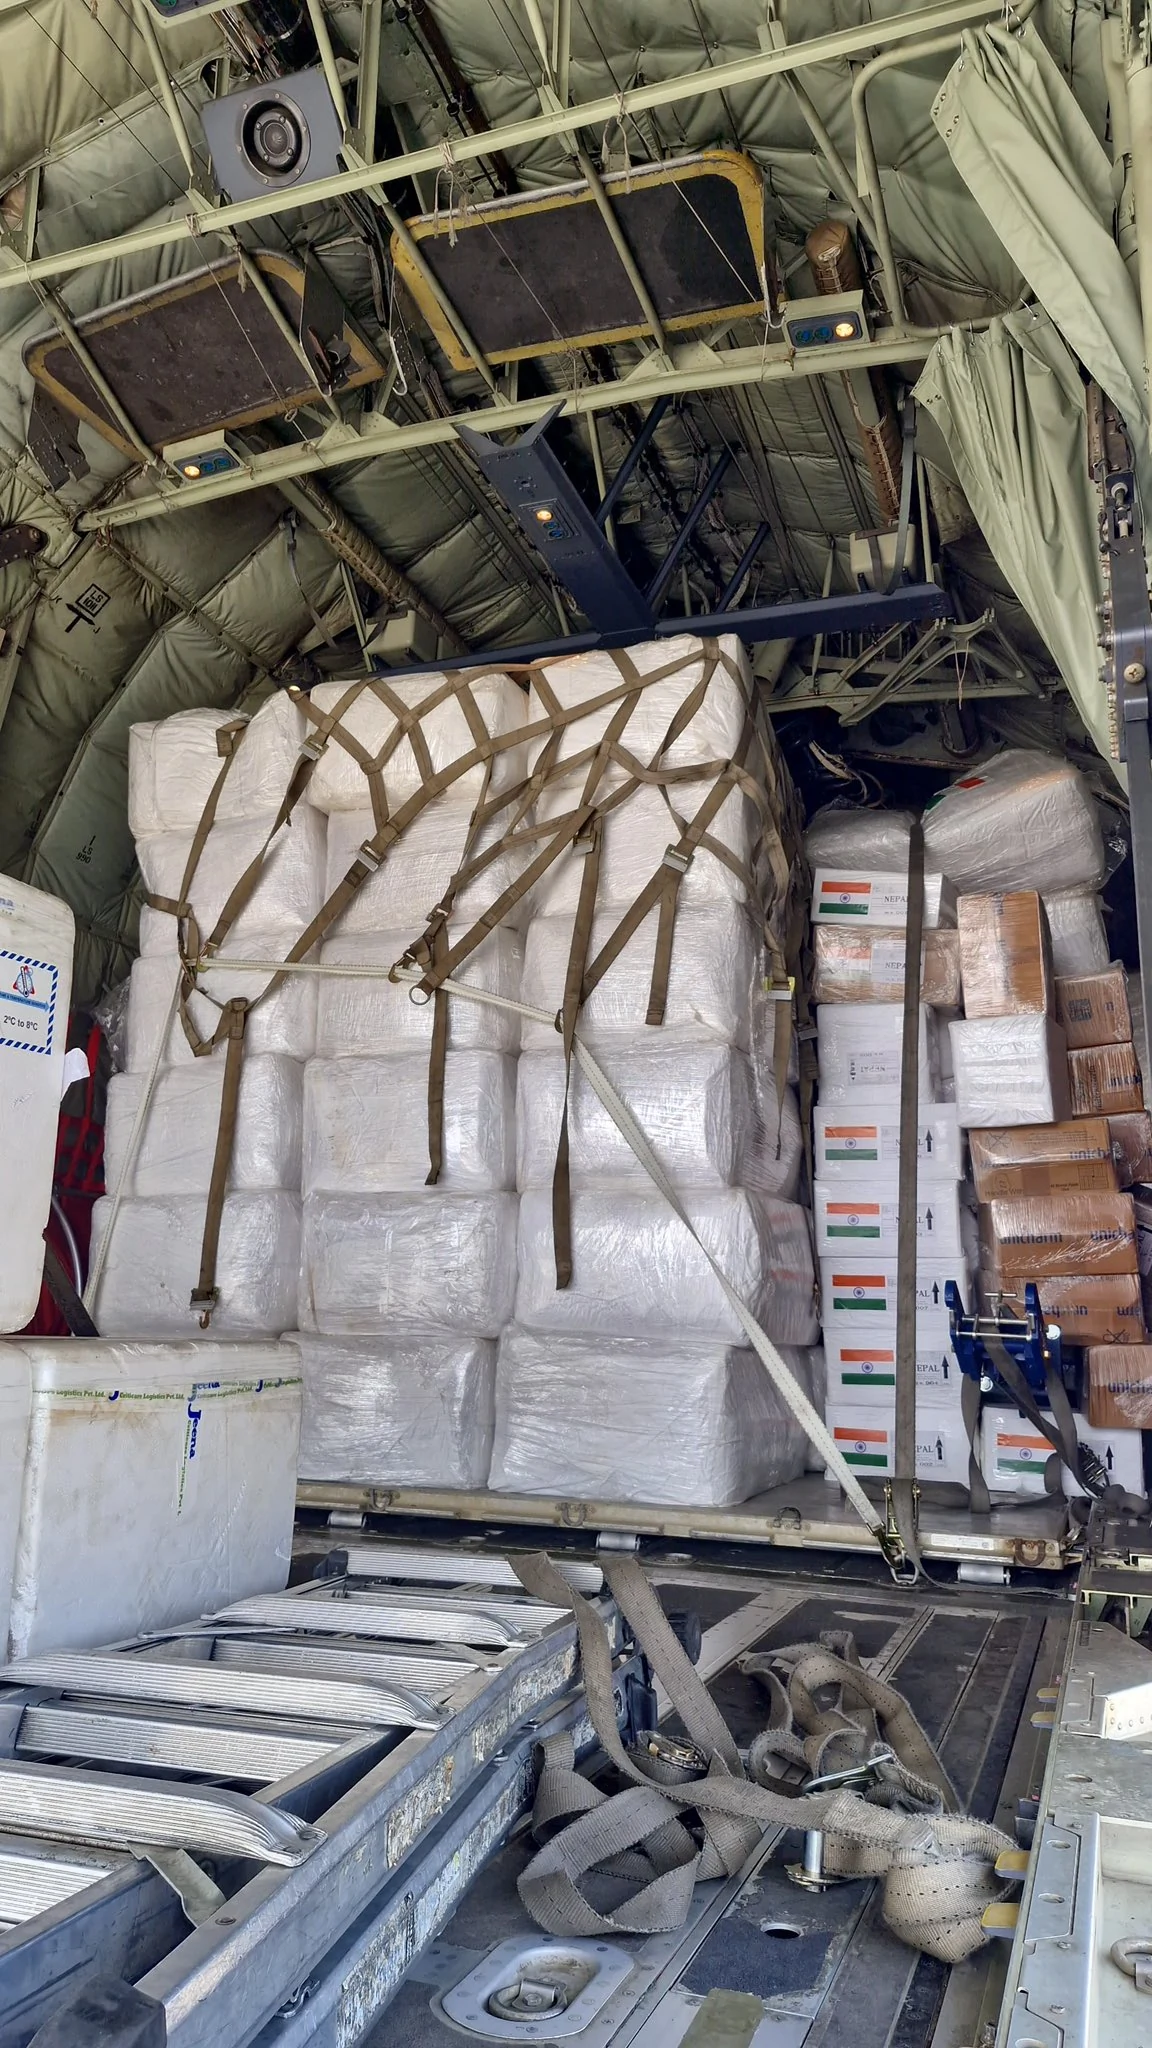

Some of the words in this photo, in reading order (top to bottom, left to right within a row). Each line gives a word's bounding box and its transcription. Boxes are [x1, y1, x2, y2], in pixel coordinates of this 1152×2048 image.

[90, 590, 104, 603] LS
[82, 845, 93, 855] LS
[76, 852, 92, 864] 990
[3, 1015, 16, 1026] 2°C
[17, 1019, 25, 1028] to
[26, 1020, 38, 1031] 8°C
[187, 1402, 202, 1459] Jeena
